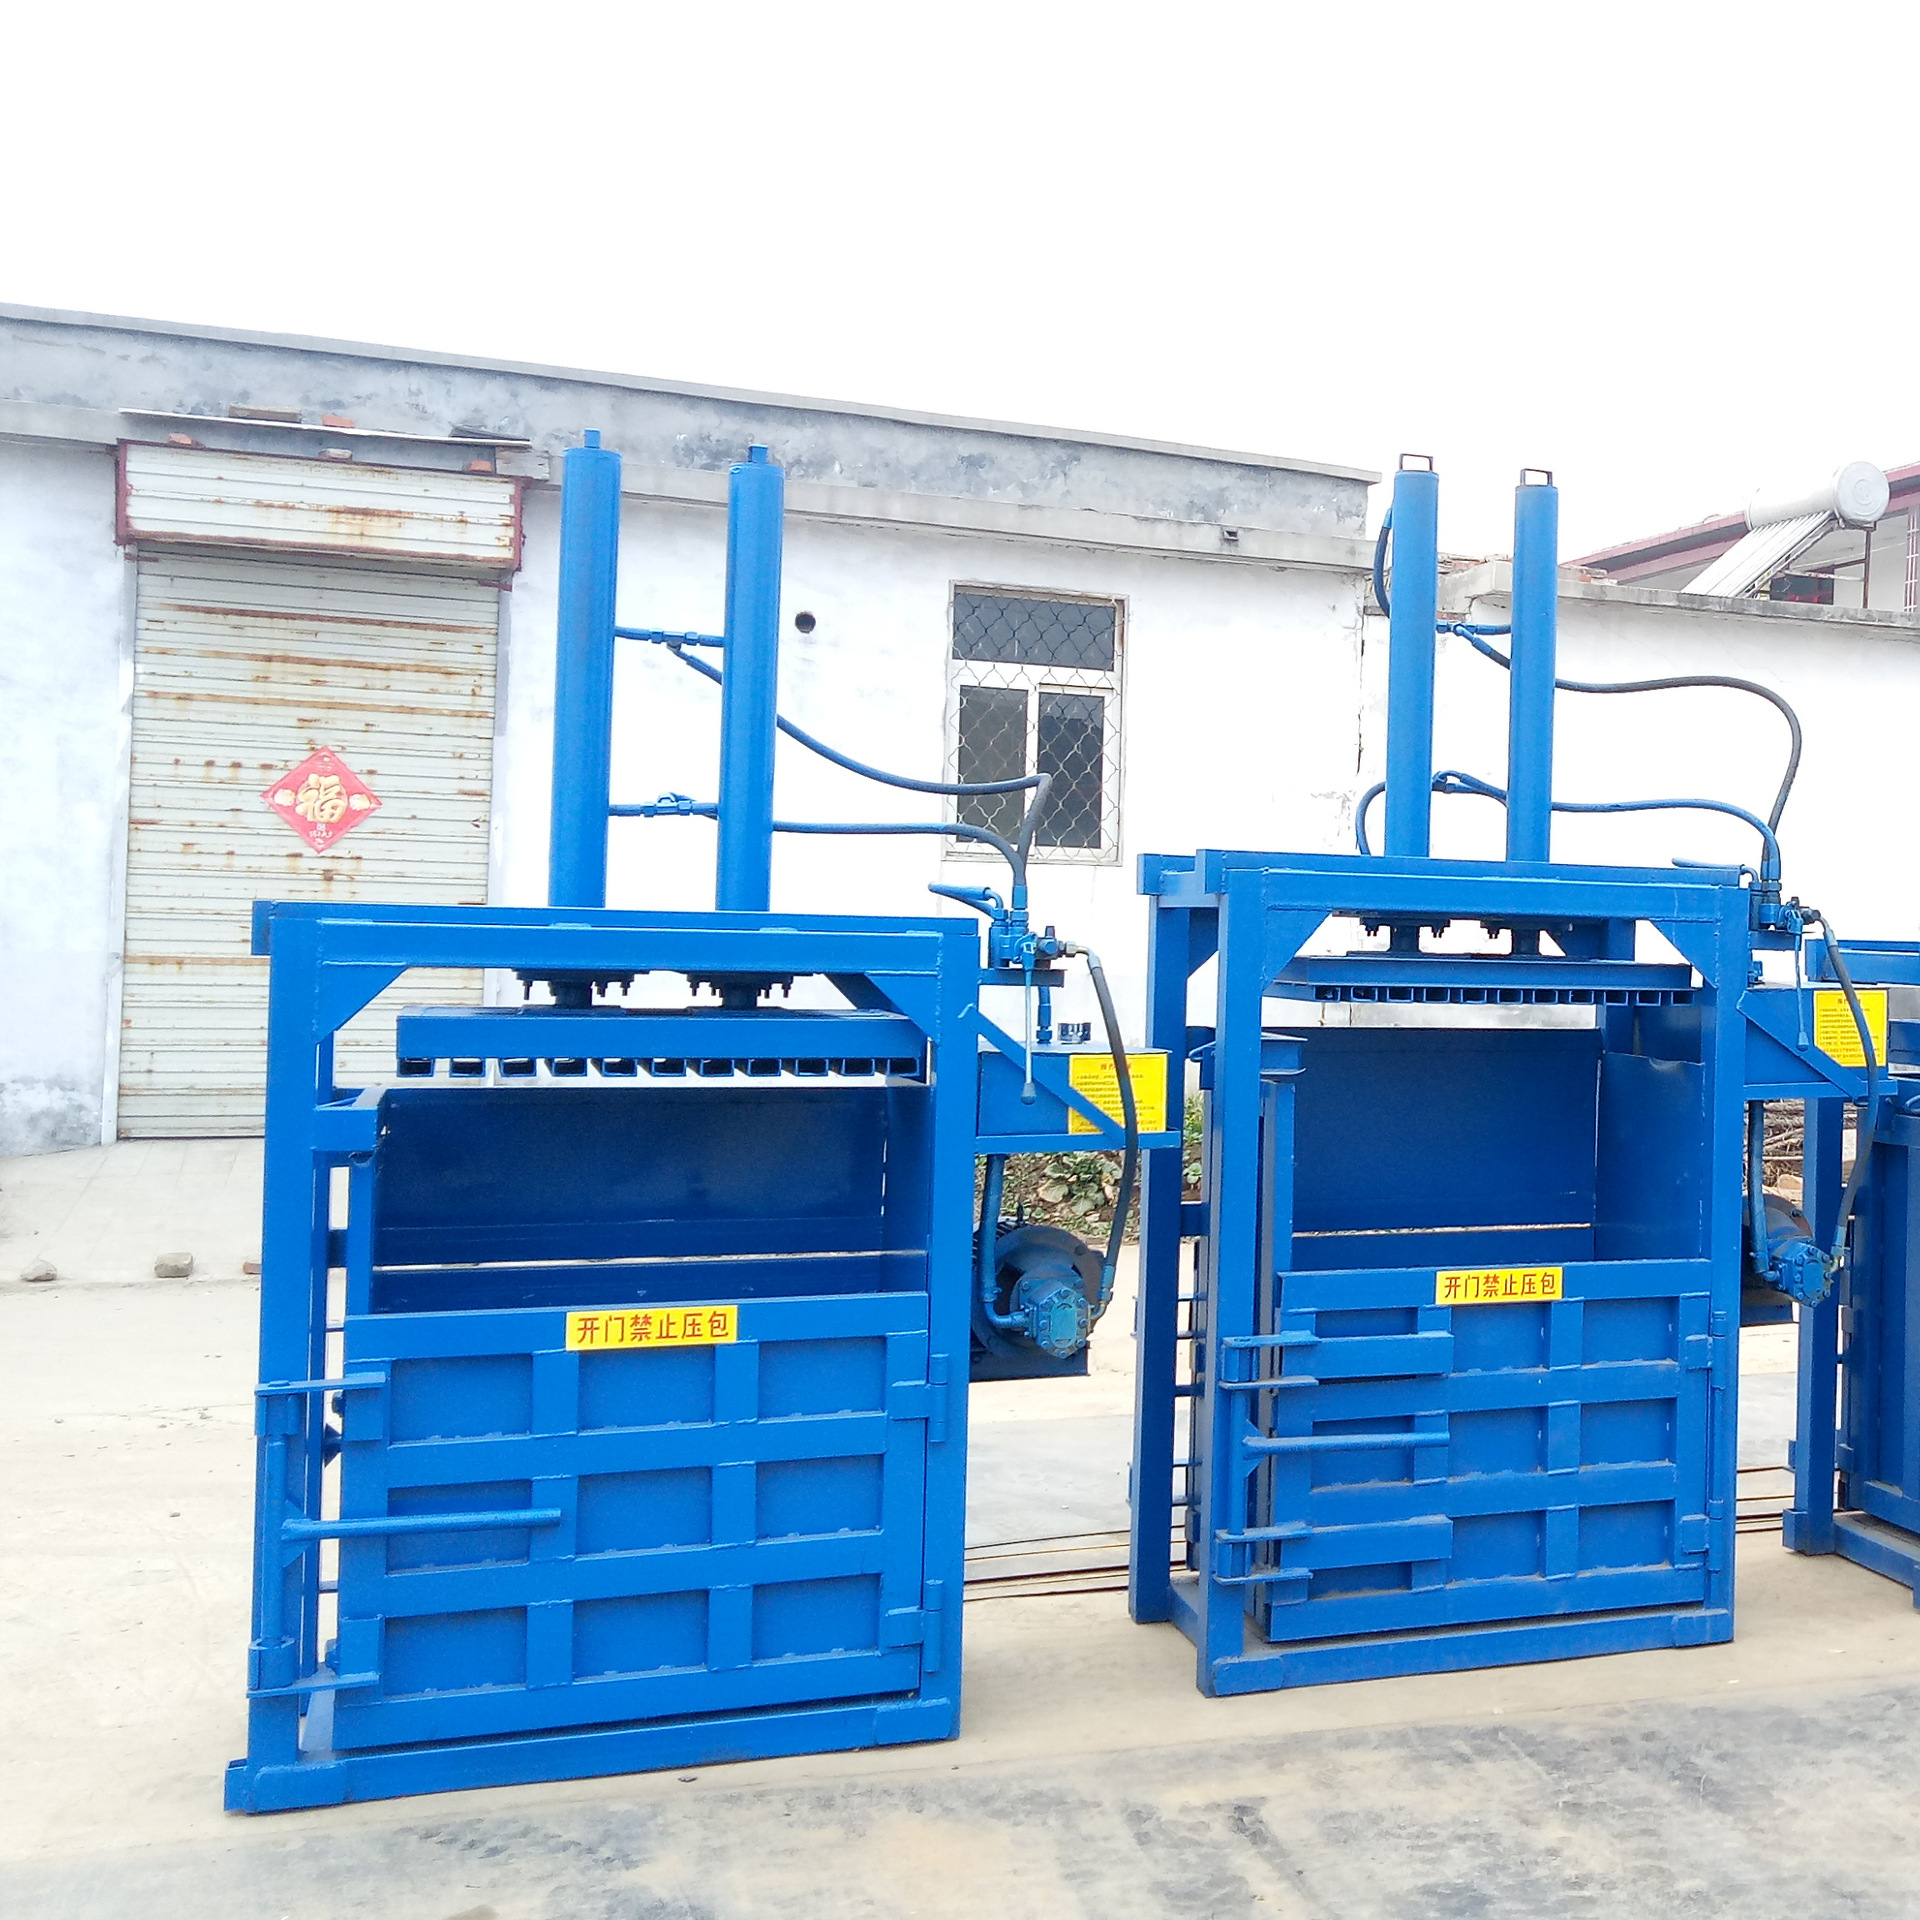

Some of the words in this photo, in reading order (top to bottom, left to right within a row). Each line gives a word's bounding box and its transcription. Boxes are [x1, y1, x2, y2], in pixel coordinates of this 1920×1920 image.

[295, 773, 348, 823] 福
[1444, 1272, 1556, 1299] 开门禁止压包
[577, 1311, 729, 1344] 开门禁止压包
